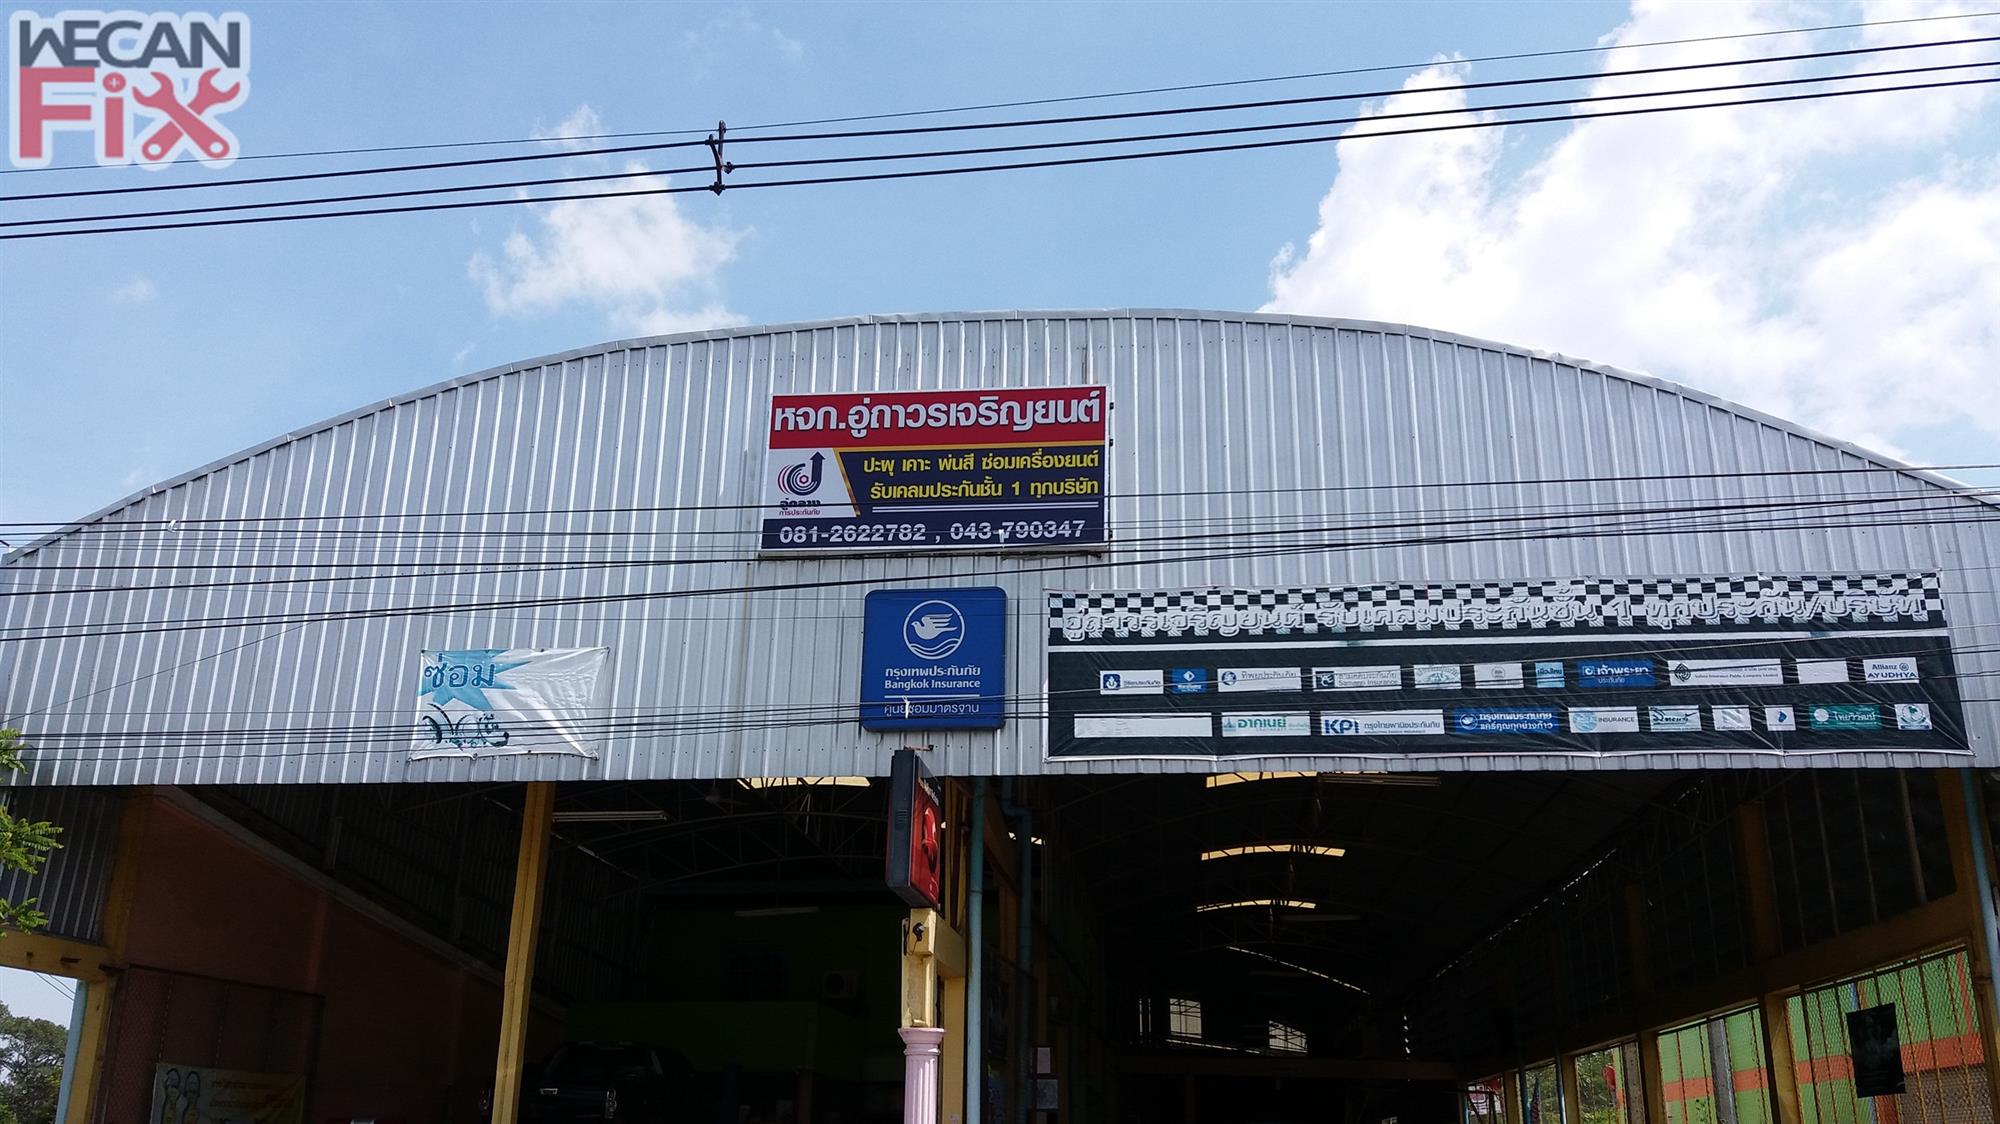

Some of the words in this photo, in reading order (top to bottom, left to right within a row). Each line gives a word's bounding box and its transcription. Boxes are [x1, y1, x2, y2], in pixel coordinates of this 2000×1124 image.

[774, 390, 1100, 438] หจก.อู่ถาวรเจริญยนต์
[863, 456, 895, 477] ปะผุ
[902, 458, 931, 473] เคาะ
[938, 452, 975, 472] พ่นสี
[982, 448, 1099, 470] ซ่อมเครื่องยนต์
[870, 475, 1003, 499] รับเคลมประกันชั้น
[1012, 481, 1020, 496] 1
[1030, 476, 1099, 499] ทุกบริษัท
[779, 523, 926, 544] 081-2622782
[950, 519, 1086, 540] 043-790347
[424, 652, 495, 688] ซ่อม
[885, 664, 981, 680] กรุงเทพประกันภัย
[1867, 671, 1917, 679] AYUDHYA
[884, 678, 930, 691] Bangkok
[931, 678, 981, 689] Insurance
[1324, 719, 1360, 734] KPI
